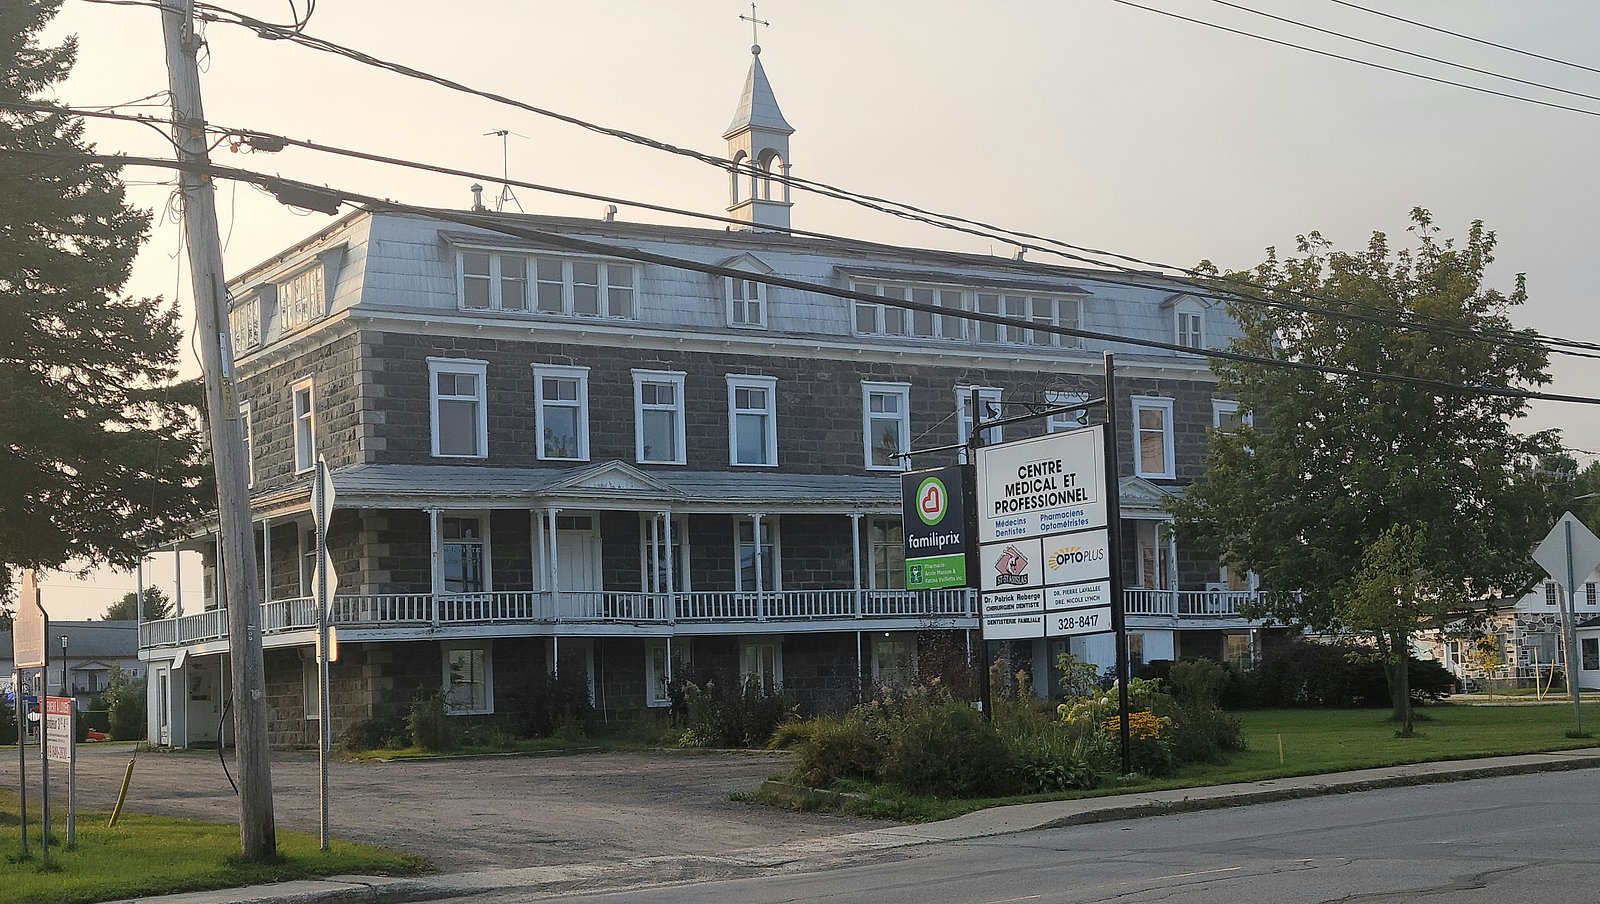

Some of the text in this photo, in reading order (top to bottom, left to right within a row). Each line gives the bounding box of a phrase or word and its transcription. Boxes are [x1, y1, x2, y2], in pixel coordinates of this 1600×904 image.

[1018, 460, 1062, 479] CENTRE
[1005, 473, 1076, 497] MEDICAL ET
[995, 488, 1088, 514] PROFESSIONNEL
[1040, 509, 1084, 521] Pharmaciens
[995, 517, 1027, 529] Médecins
[1040, 518, 1089, 532] Optométristes
[995, 527, 1026, 538] Dentistes
[909, 531, 960, 550] familiprix
[994, 594, 1014, 603] Patrick
[1016, 593, 1041, 601] Roberge
[986, 601, 1040, 611] CHIRURGIEN DENTISTE
[1058, 614, 1099, 630] 328-8417
